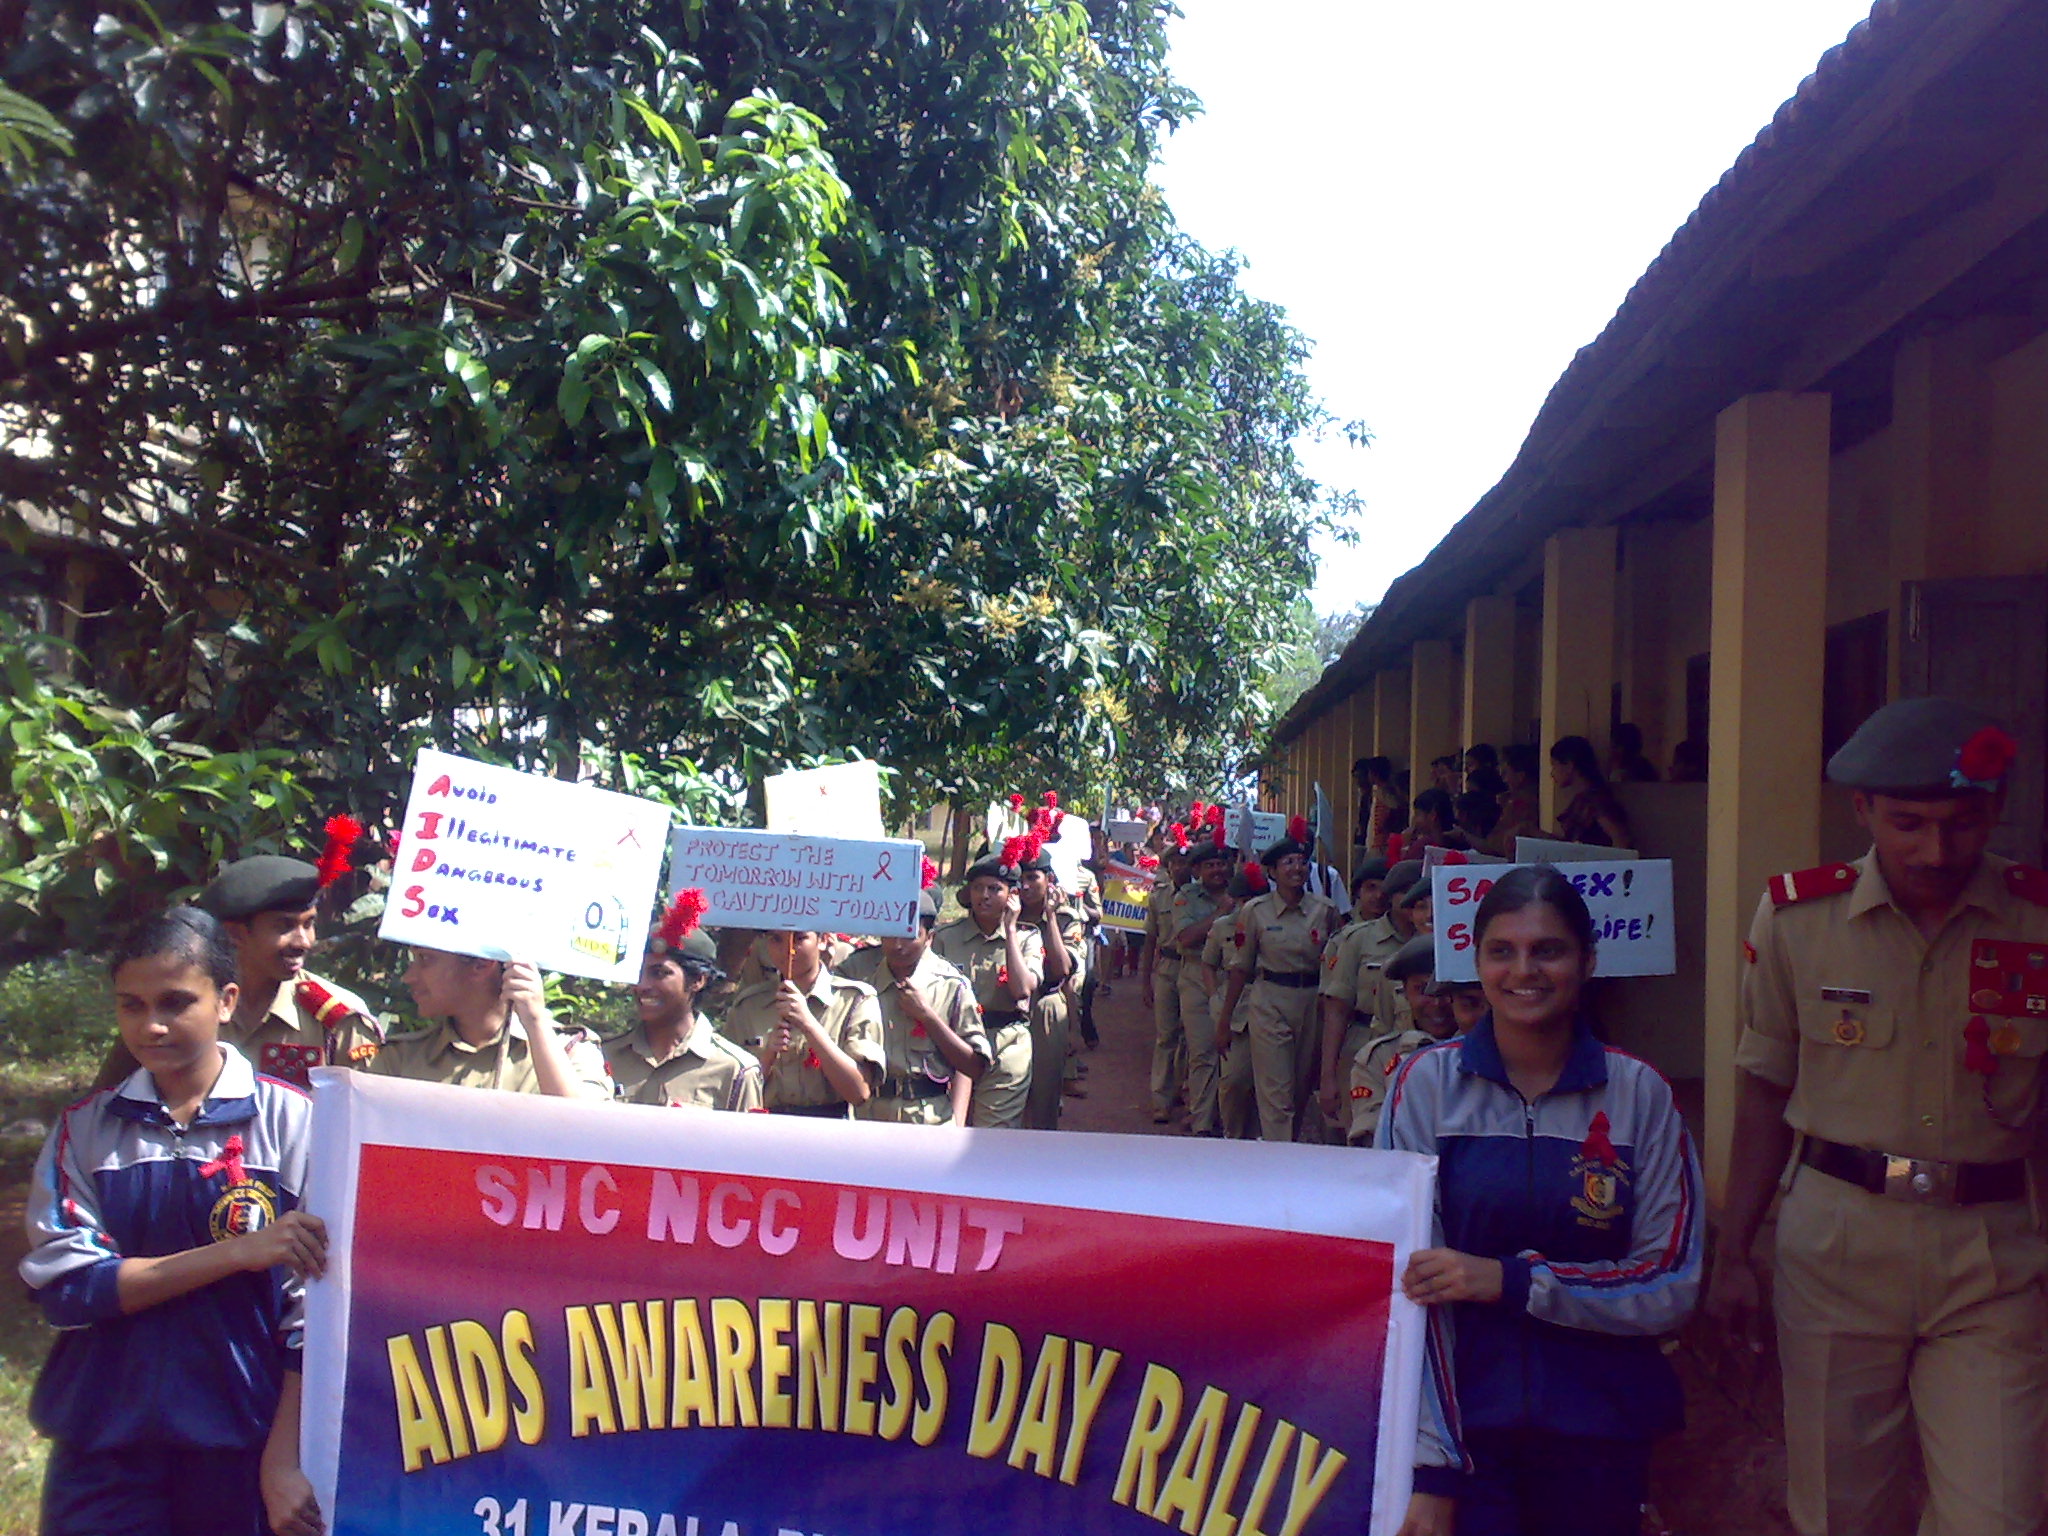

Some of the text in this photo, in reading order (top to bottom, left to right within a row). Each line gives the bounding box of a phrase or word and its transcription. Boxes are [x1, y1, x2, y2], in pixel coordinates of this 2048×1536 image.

[687, 839, 835, 866] PROTECT THE
[686, 864, 864, 893] TOMORROW WITH
[712, 889, 916, 933] CAUTIOUS TODAY!
[475, 1165, 1026, 1275] SNC NCC UNIT
[386, 1297, 1348, 1536] AIDS AWARENESS DAY RALLY
